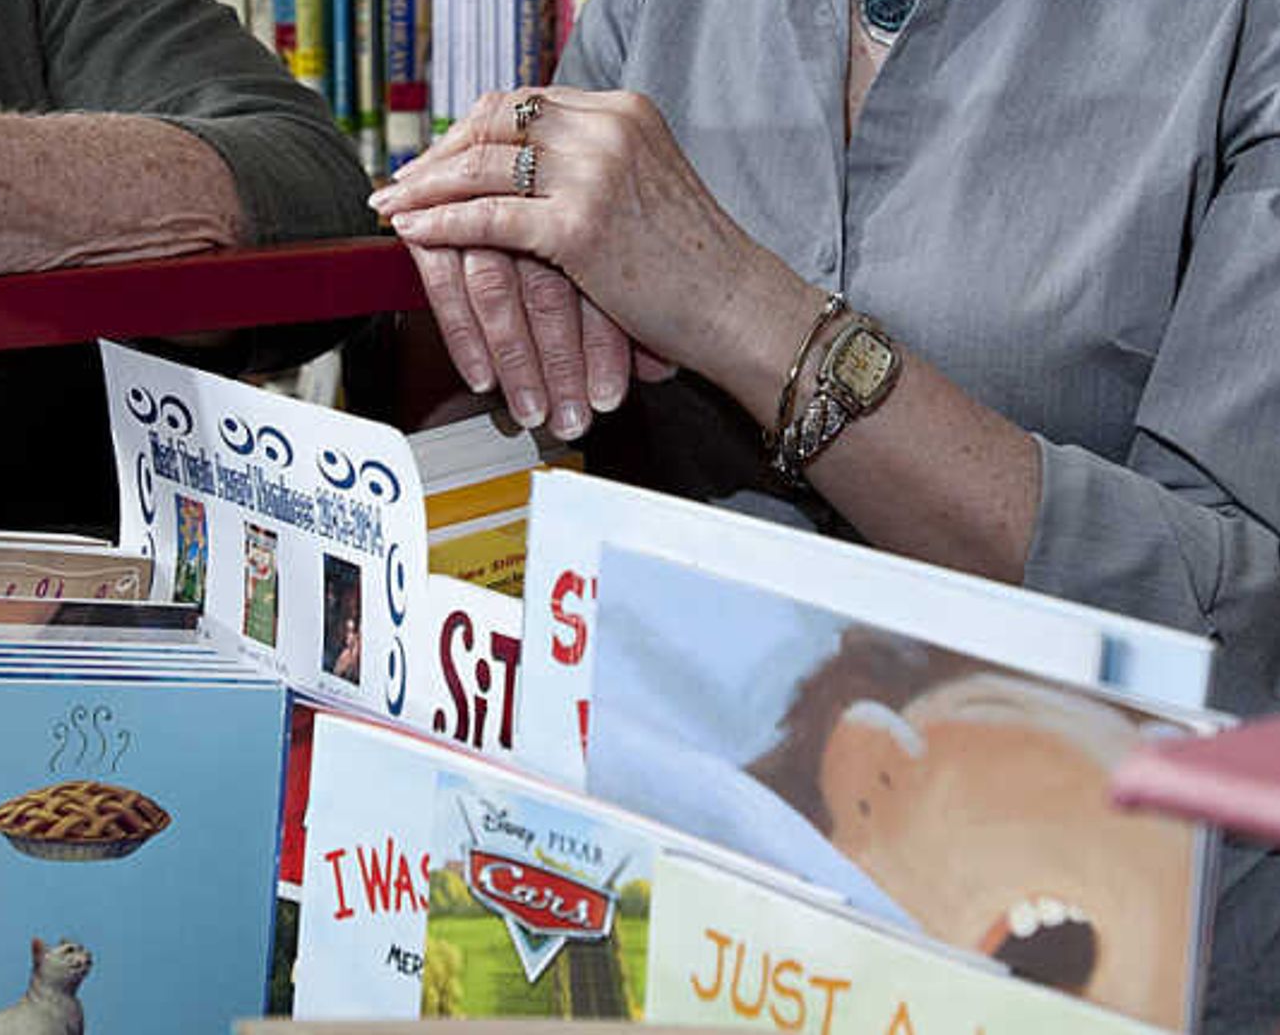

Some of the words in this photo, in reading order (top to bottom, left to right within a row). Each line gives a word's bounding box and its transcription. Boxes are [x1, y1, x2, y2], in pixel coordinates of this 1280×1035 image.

[547, 828, 605, 863] PIXAR
[324, 848, 356, 921] I
[477, 863, 593, 929] Cars
[690, 927, 852, 1035] JUST
